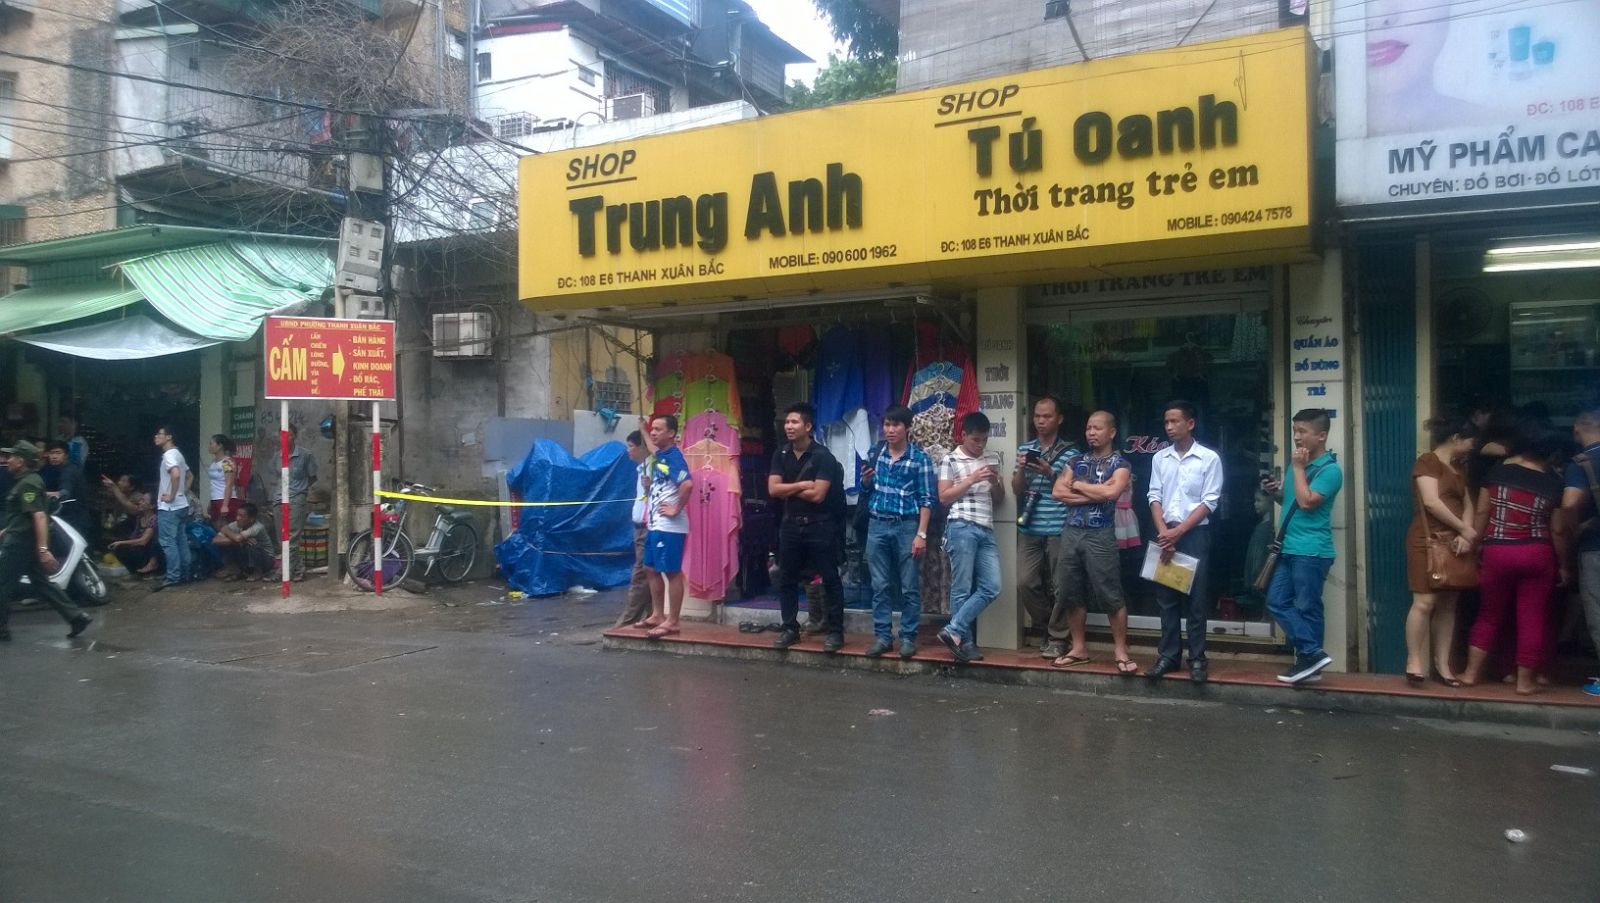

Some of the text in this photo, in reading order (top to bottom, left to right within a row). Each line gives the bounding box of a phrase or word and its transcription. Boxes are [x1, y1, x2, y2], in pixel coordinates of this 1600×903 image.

[936, 84, 1020, 115] SHOP
[1527, 102, 1553, 116] ĐC:
[1560, 99, 1584, 112] 108
[967, 93, 1238, 177] Tú Oanh
[1388, 139, 1438, 174] MỸ
[1449, 125, 1545, 168] PHẨM
[566, 149, 637, 182] SHOP
[974, 162, 1259, 216] Thời trang trẻ em
[1388, 176, 1460, 197] CHUYÊN:
[569, 162, 863, 257] Trung Anh
[1265, 206, 1293, 221] 7578
[940, 224, 1090, 253] ĐC: 108 E6 THANH XUÂN BẮC
[557, 258, 724, 289] ĐC: 108 E6 THANH XUÂN BẮC
[769, 252, 819, 269] MOBILE:
[1232, 266, 1267, 283] EM
[352, 335, 386, 345] BÁN HÀNG
[352, 347, 366, 357] SẢN
[269, 334, 307, 381] CẤM
[353, 362, 392, 371] KINH DOANH
